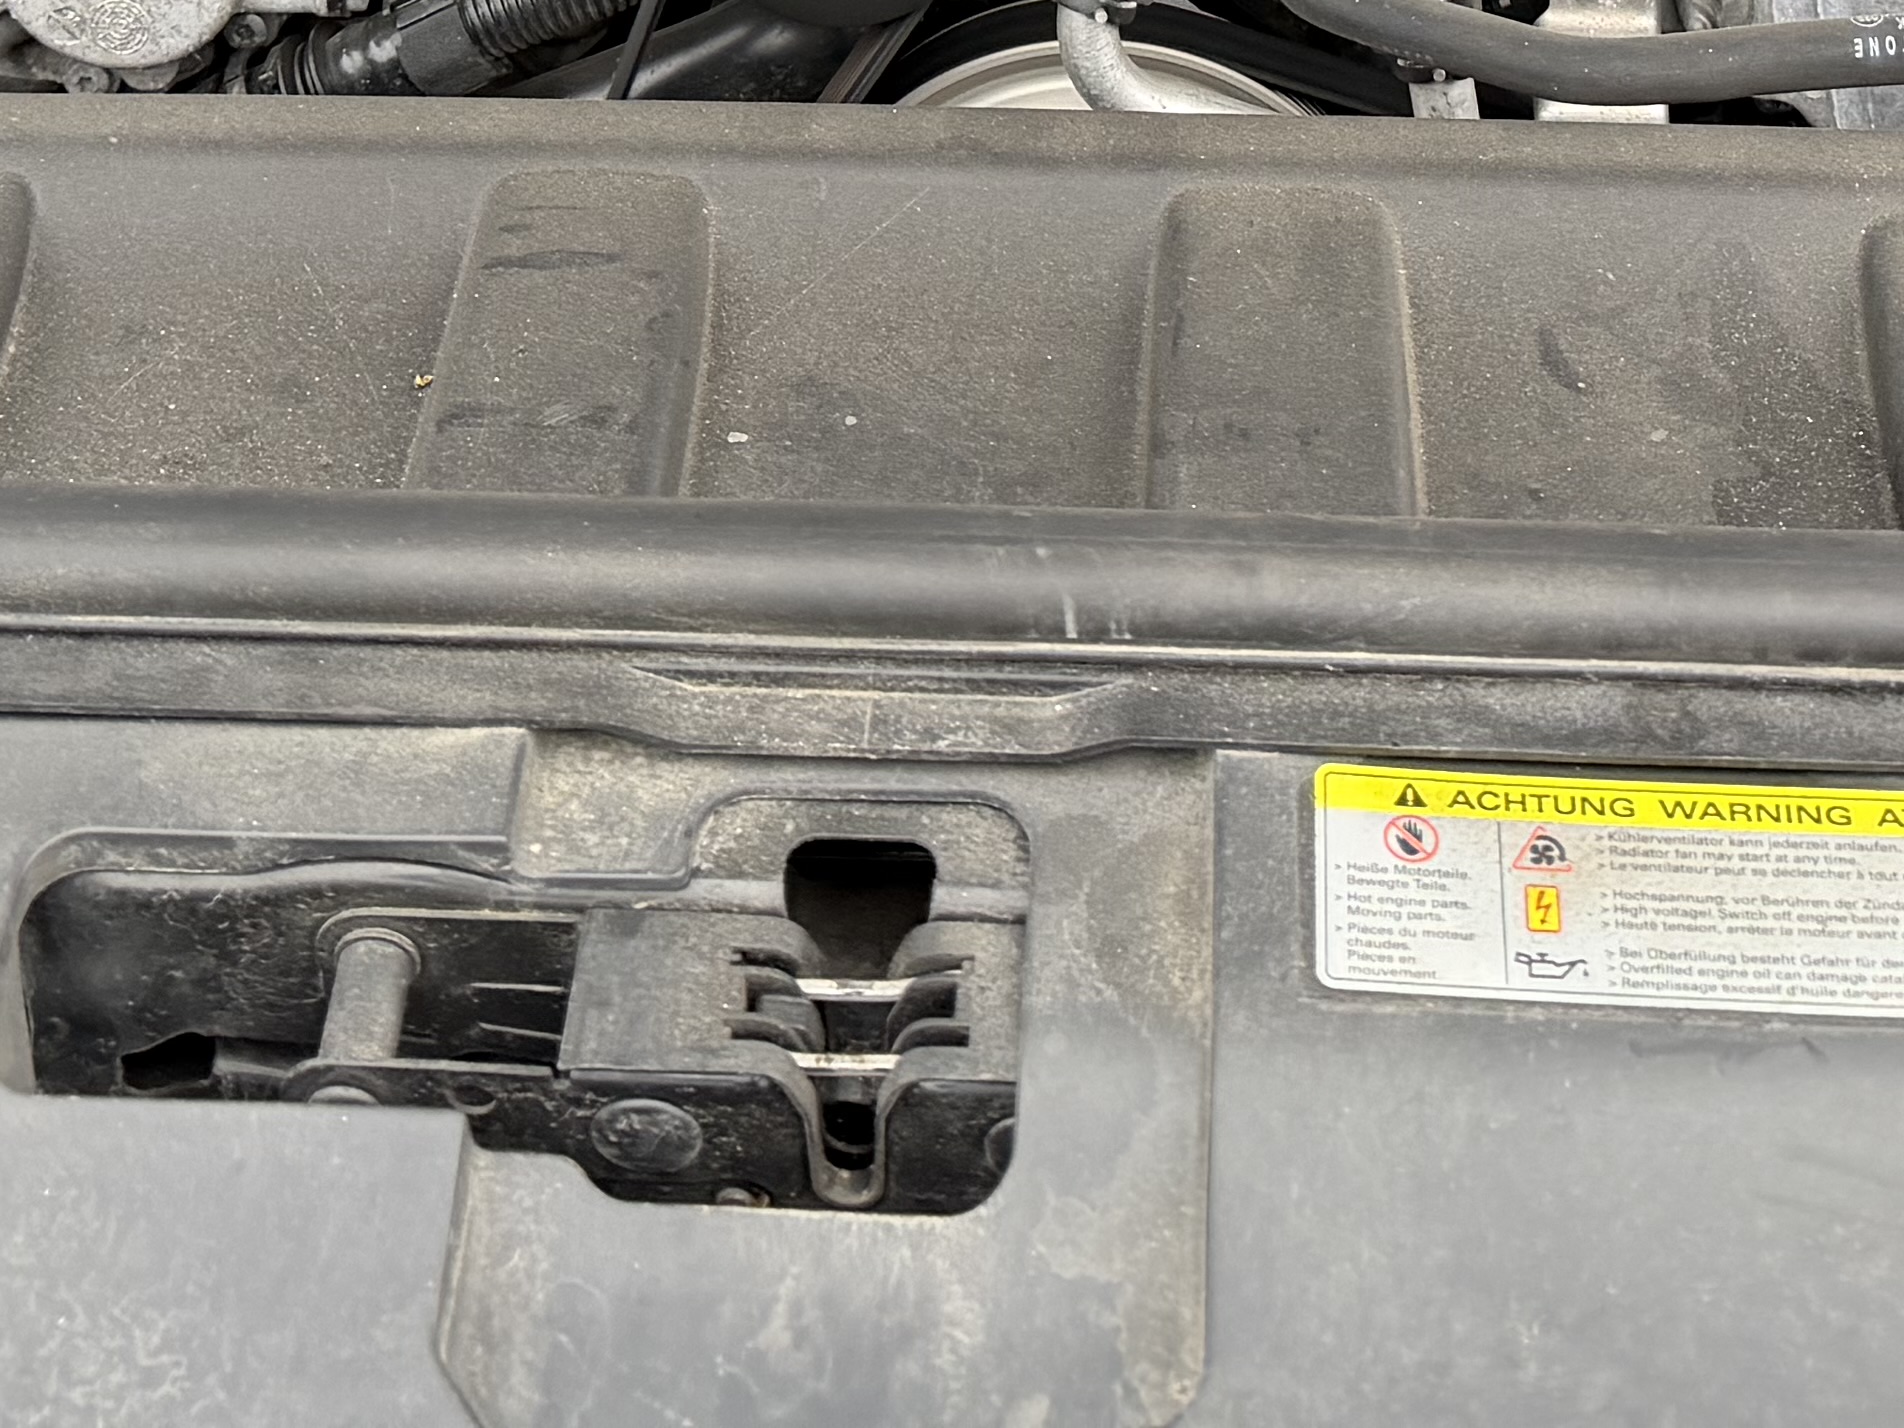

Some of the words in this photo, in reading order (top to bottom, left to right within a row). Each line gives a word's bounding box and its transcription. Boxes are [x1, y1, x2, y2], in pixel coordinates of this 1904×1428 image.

[1446, 789, 1636, 821] ACHTUNG
[1659, 799, 1854, 827] WARNING
[1607, 831, 1724, 847] Kühlerventilator
[1728, 834, 1764, 848] kann
[1767, 836, 1830, 853] jederzeit
[1834, 840, 1903, 855] anlaufen.
[1608, 845, 1670, 860] Radiator
[1674, 847, 1697, 860] fan
[1702, 850, 1733, 864] may
[1737, 851, 1771, 864] start
[1774, 853, 1790, 864] at
[1792, 855, 1819, 867] any
[1823, 853, 1860, 866] time.
[1346, 860, 1389, 876] Heiße
[1393, 864, 1472, 882] Motorteile.
[1609, 860, 1626, 872] Le
[1629, 859, 1709, 875] ventilateur
[1713, 864, 1746, 879] peut
[1750, 868, 1768, 878] se
[1869, 869, 1899, 882] tout
[1346, 875, 1410, 892] Bewegte
[1415, 878, 1452, 893] Teile.
[1346, 891, 1373, 906] Hot
[1376, 895, 1427, 912] engine
[1431, 896, 1473, 912] parts.
[1732, 895, 1758, 907] vor
[1761, 894, 1831, 910] Berühren
[1836, 898, 1859, 911] der
[1346, 904, 1403, 922] Moving
[1407, 909, 1447, 925] parts.
[1613, 904, 1647, 920] High
[1717, 907, 1769, 922] Switch
[1772, 910, 1793, 922] off
[1796, 912, 1848, 926] engine
[1850, 913, 1901, 927] before
[1398, 925, 1418, 939] du
[1421, 927, 1476, 942] moteur
[1797, 926, 1852, 939] moteur
[1857, 928, 1898, 942] avant
[1346, 937, 1412, 952] chaudes.
[1398, 954, 1416, 966] en
[1618, 945, 1643, 960] Bei
[1740, 951, 1796, 966] besteht
[1800, 954, 1851, 968] Gefahr
[1855, 956, 1878, 969] für
[1620, 961, 1693, 977] Overfilled
[1697, 965, 1749, 980] engine
[1752, 967, 1772, 980] oil
[1774, 970, 1802, 982] can
[1806, 971, 1868, 985] damage
[1621, 976, 1718, 994] Remplissage
[1721, 980, 1782, 996] excessif
